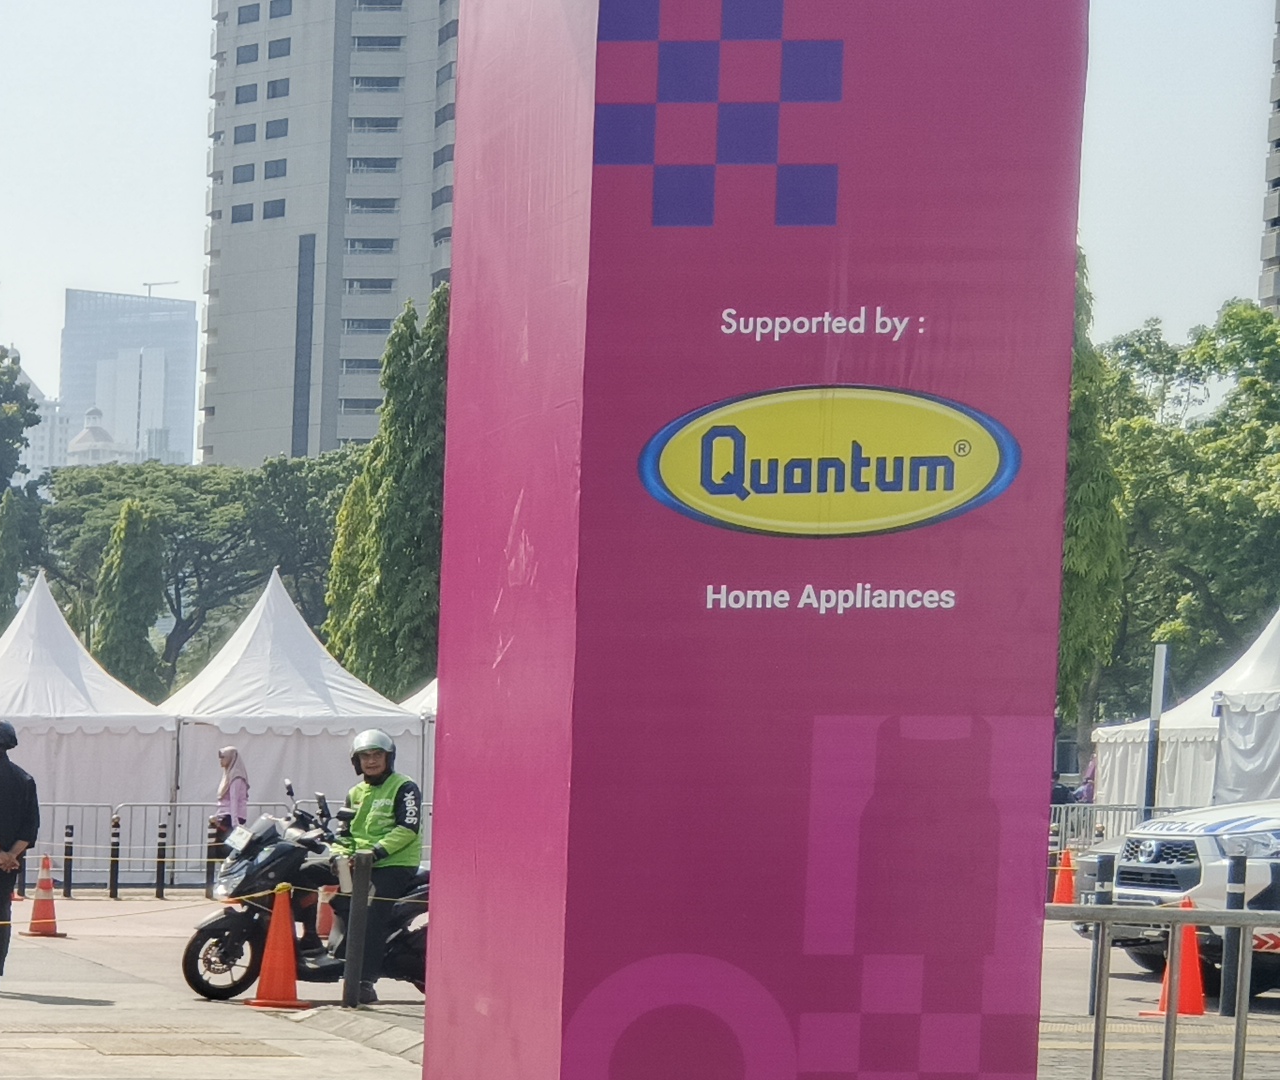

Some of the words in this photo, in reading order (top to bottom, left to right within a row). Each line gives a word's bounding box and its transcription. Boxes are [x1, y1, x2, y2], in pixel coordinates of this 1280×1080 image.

[720, 307, 867, 342] Supported
[875, 307, 910, 341] by
[706, 584, 790, 609] Home
[797, 582, 956, 614] Appliances
[403, 791, 419, 825] gojek
